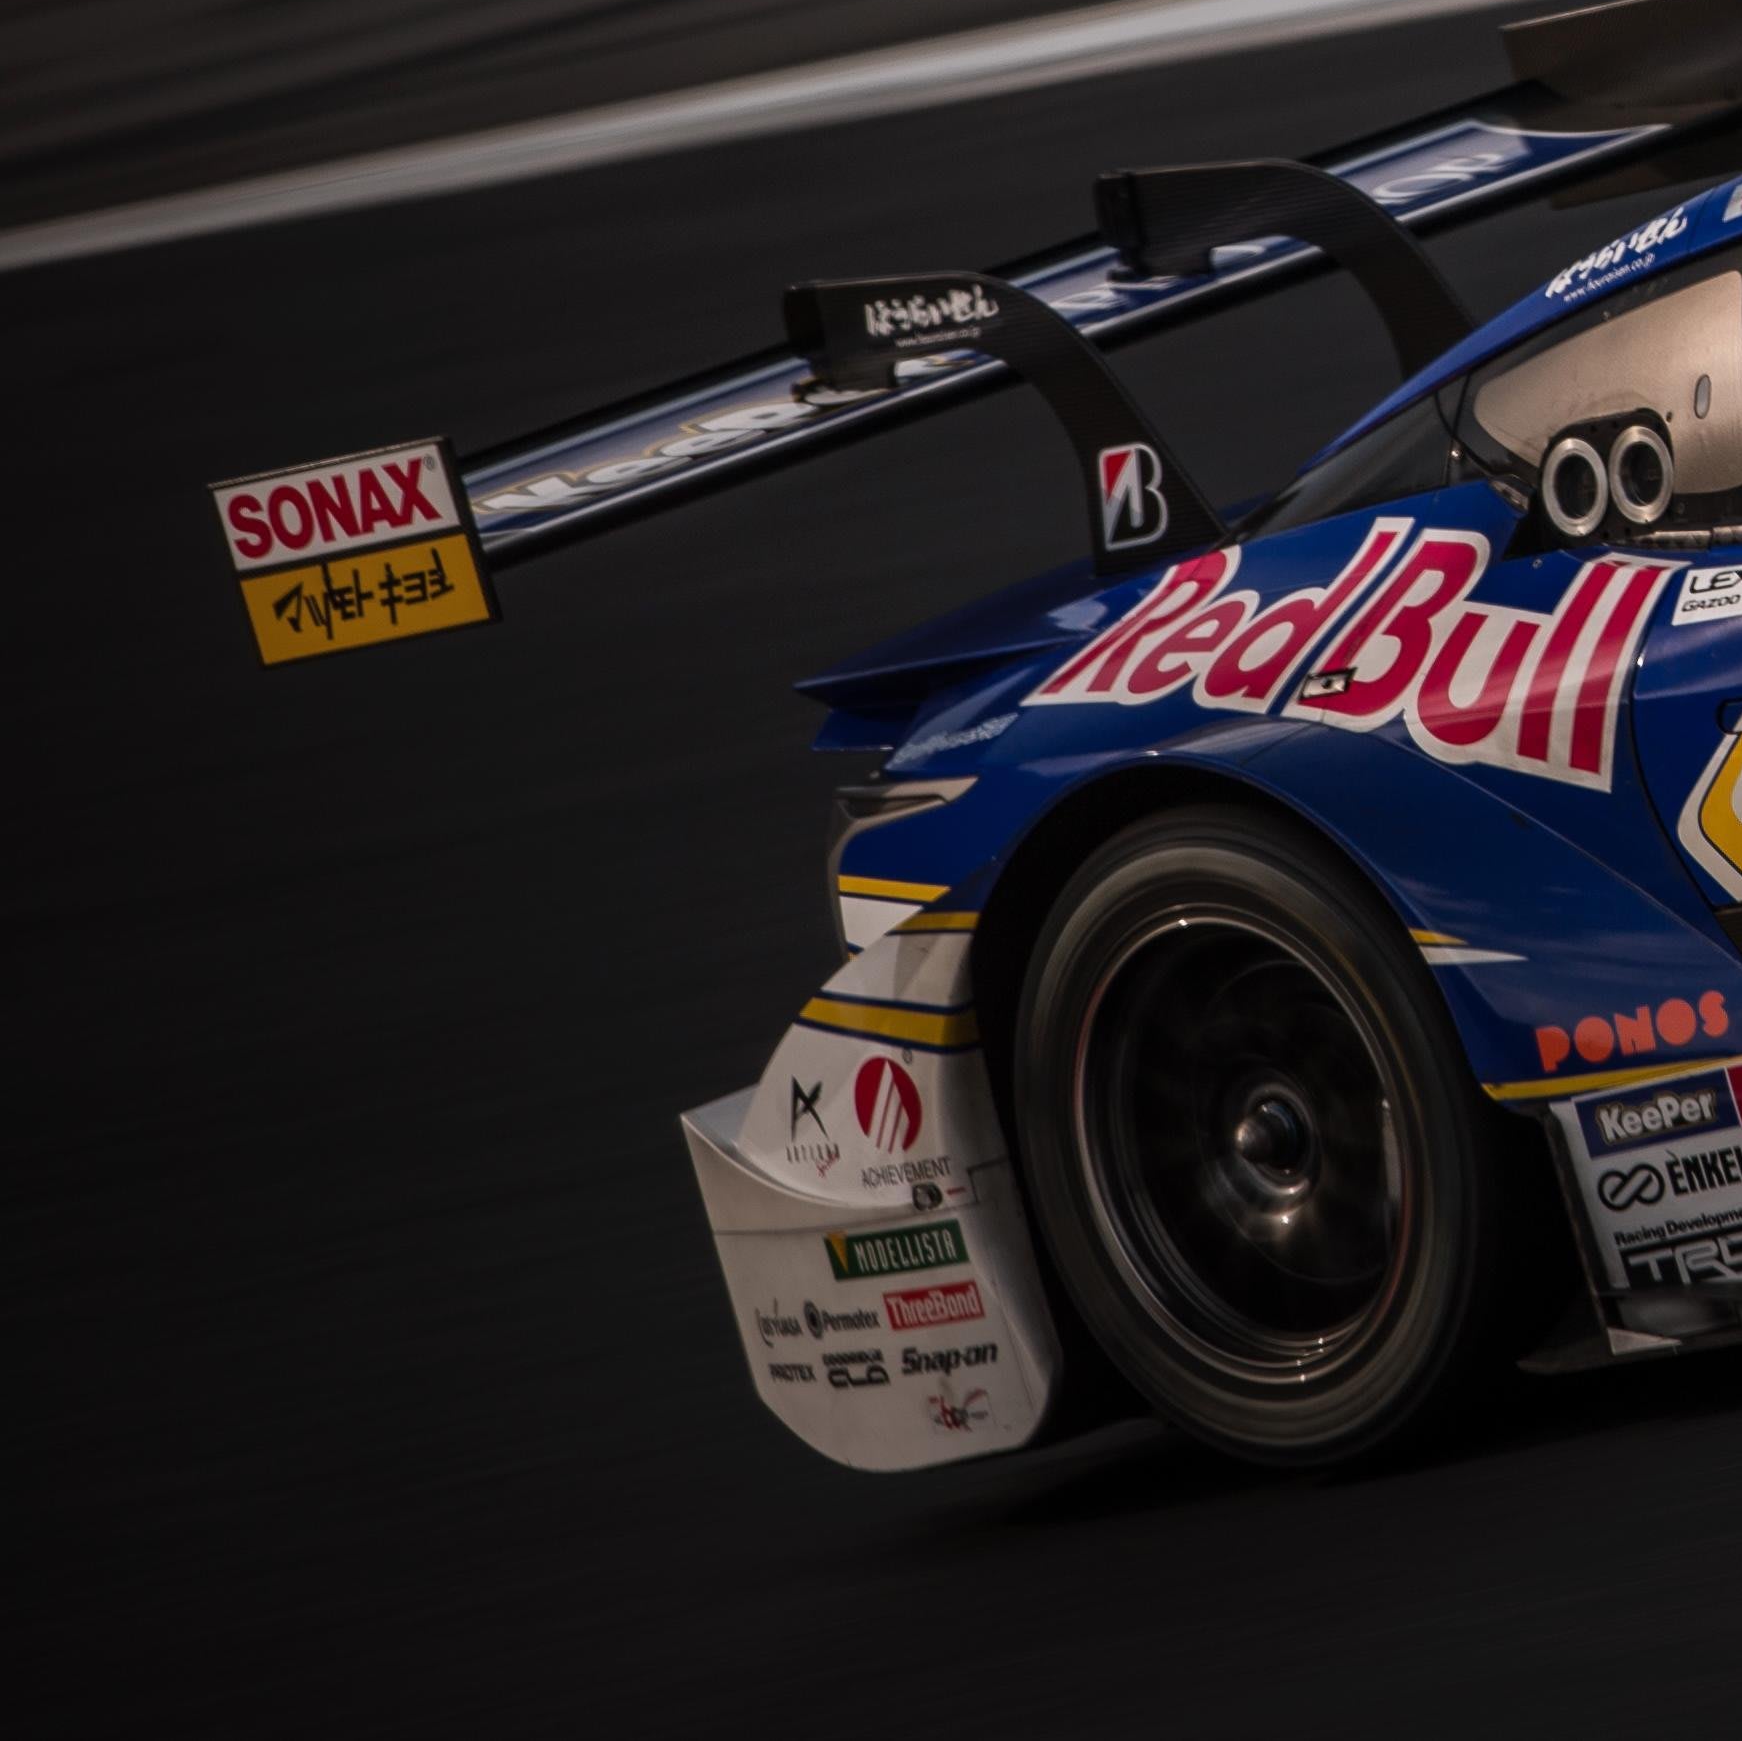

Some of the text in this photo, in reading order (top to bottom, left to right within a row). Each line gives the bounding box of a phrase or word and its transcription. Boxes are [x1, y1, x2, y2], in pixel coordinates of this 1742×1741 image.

[227, 457, 443, 559] SONAX
[1681, 594, 1741, 613] GAZOO
[1034, 524, 1674, 782] Red Bull
[1534, 989, 1729, 1074] PONOS
[1597, 1090, 1718, 1146] KeePer
[860, 1156, 953, 1189] ACHIEVEMENT
[853, 1227, 958, 1274] MODELLISTA
[1613, 1222, 1666, 1247] Racing
[888, 1280, 982, 1328] ThreeBond
